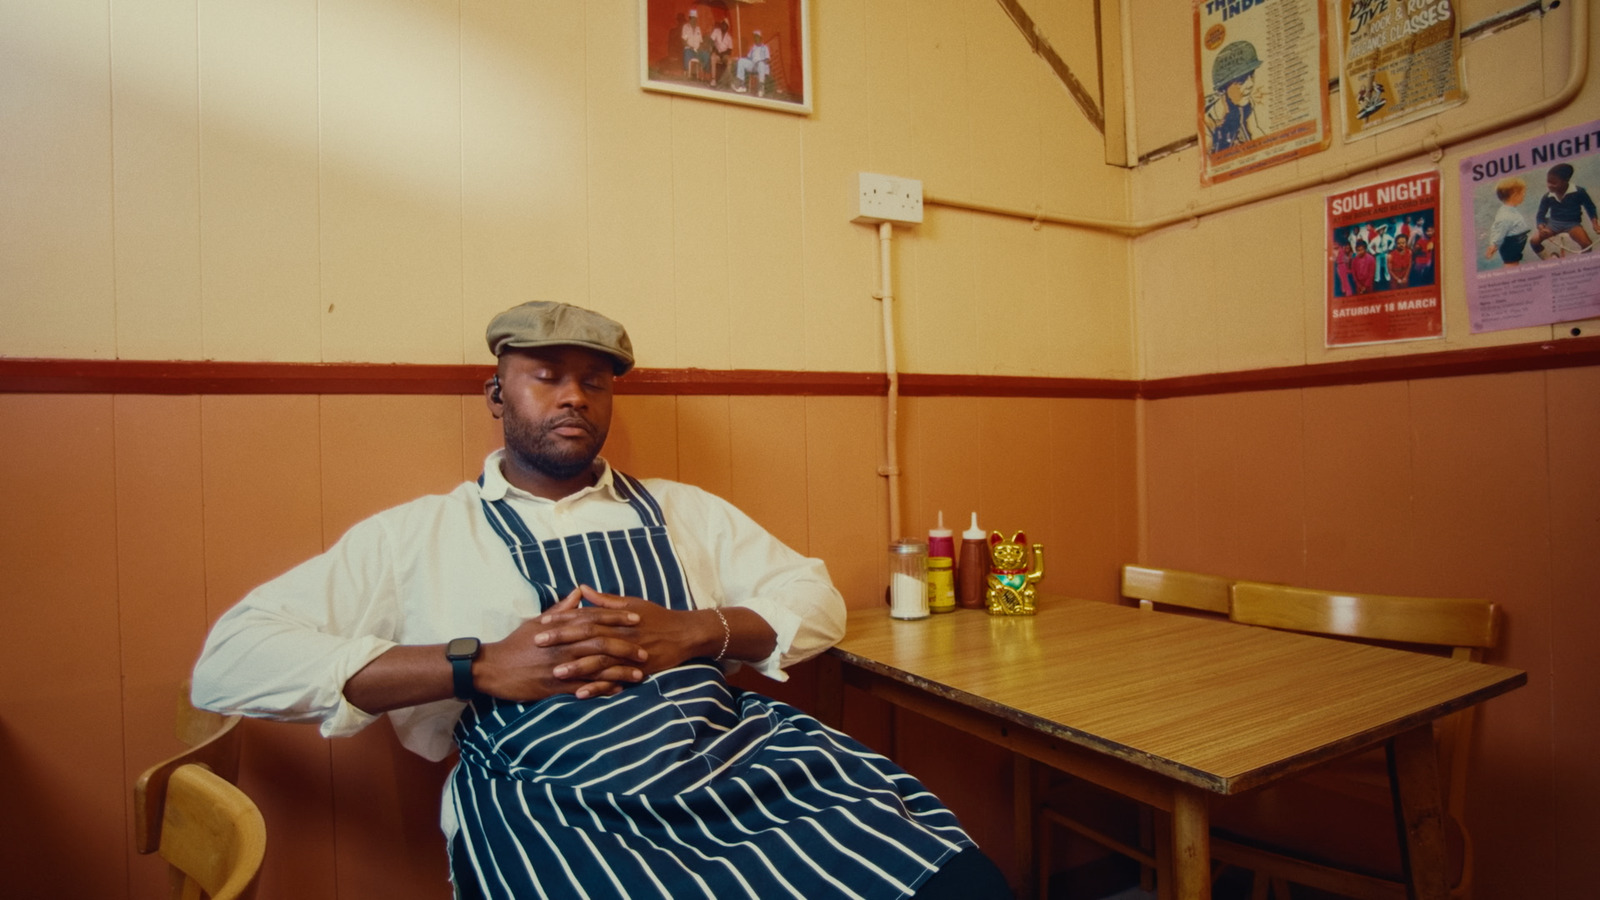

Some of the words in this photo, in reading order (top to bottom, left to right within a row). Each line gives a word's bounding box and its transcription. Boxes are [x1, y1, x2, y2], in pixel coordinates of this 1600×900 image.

[1350, 0, 1388, 35] JIVE
[1389, 0, 1451, 42] CLASSES
[1395, 7, 1403, 20] &
[1472, 152, 1525, 181] SOUL
[1531, 130, 1600, 166] NIGHT
[1332, 192, 1373, 215] SOUL
[1377, 178, 1434, 205] NIGHT
[1332, 304, 1381, 318] SATURDAY
[1384, 303, 1395, 312] 18
[1397, 297, 1437, 311] MARCH
